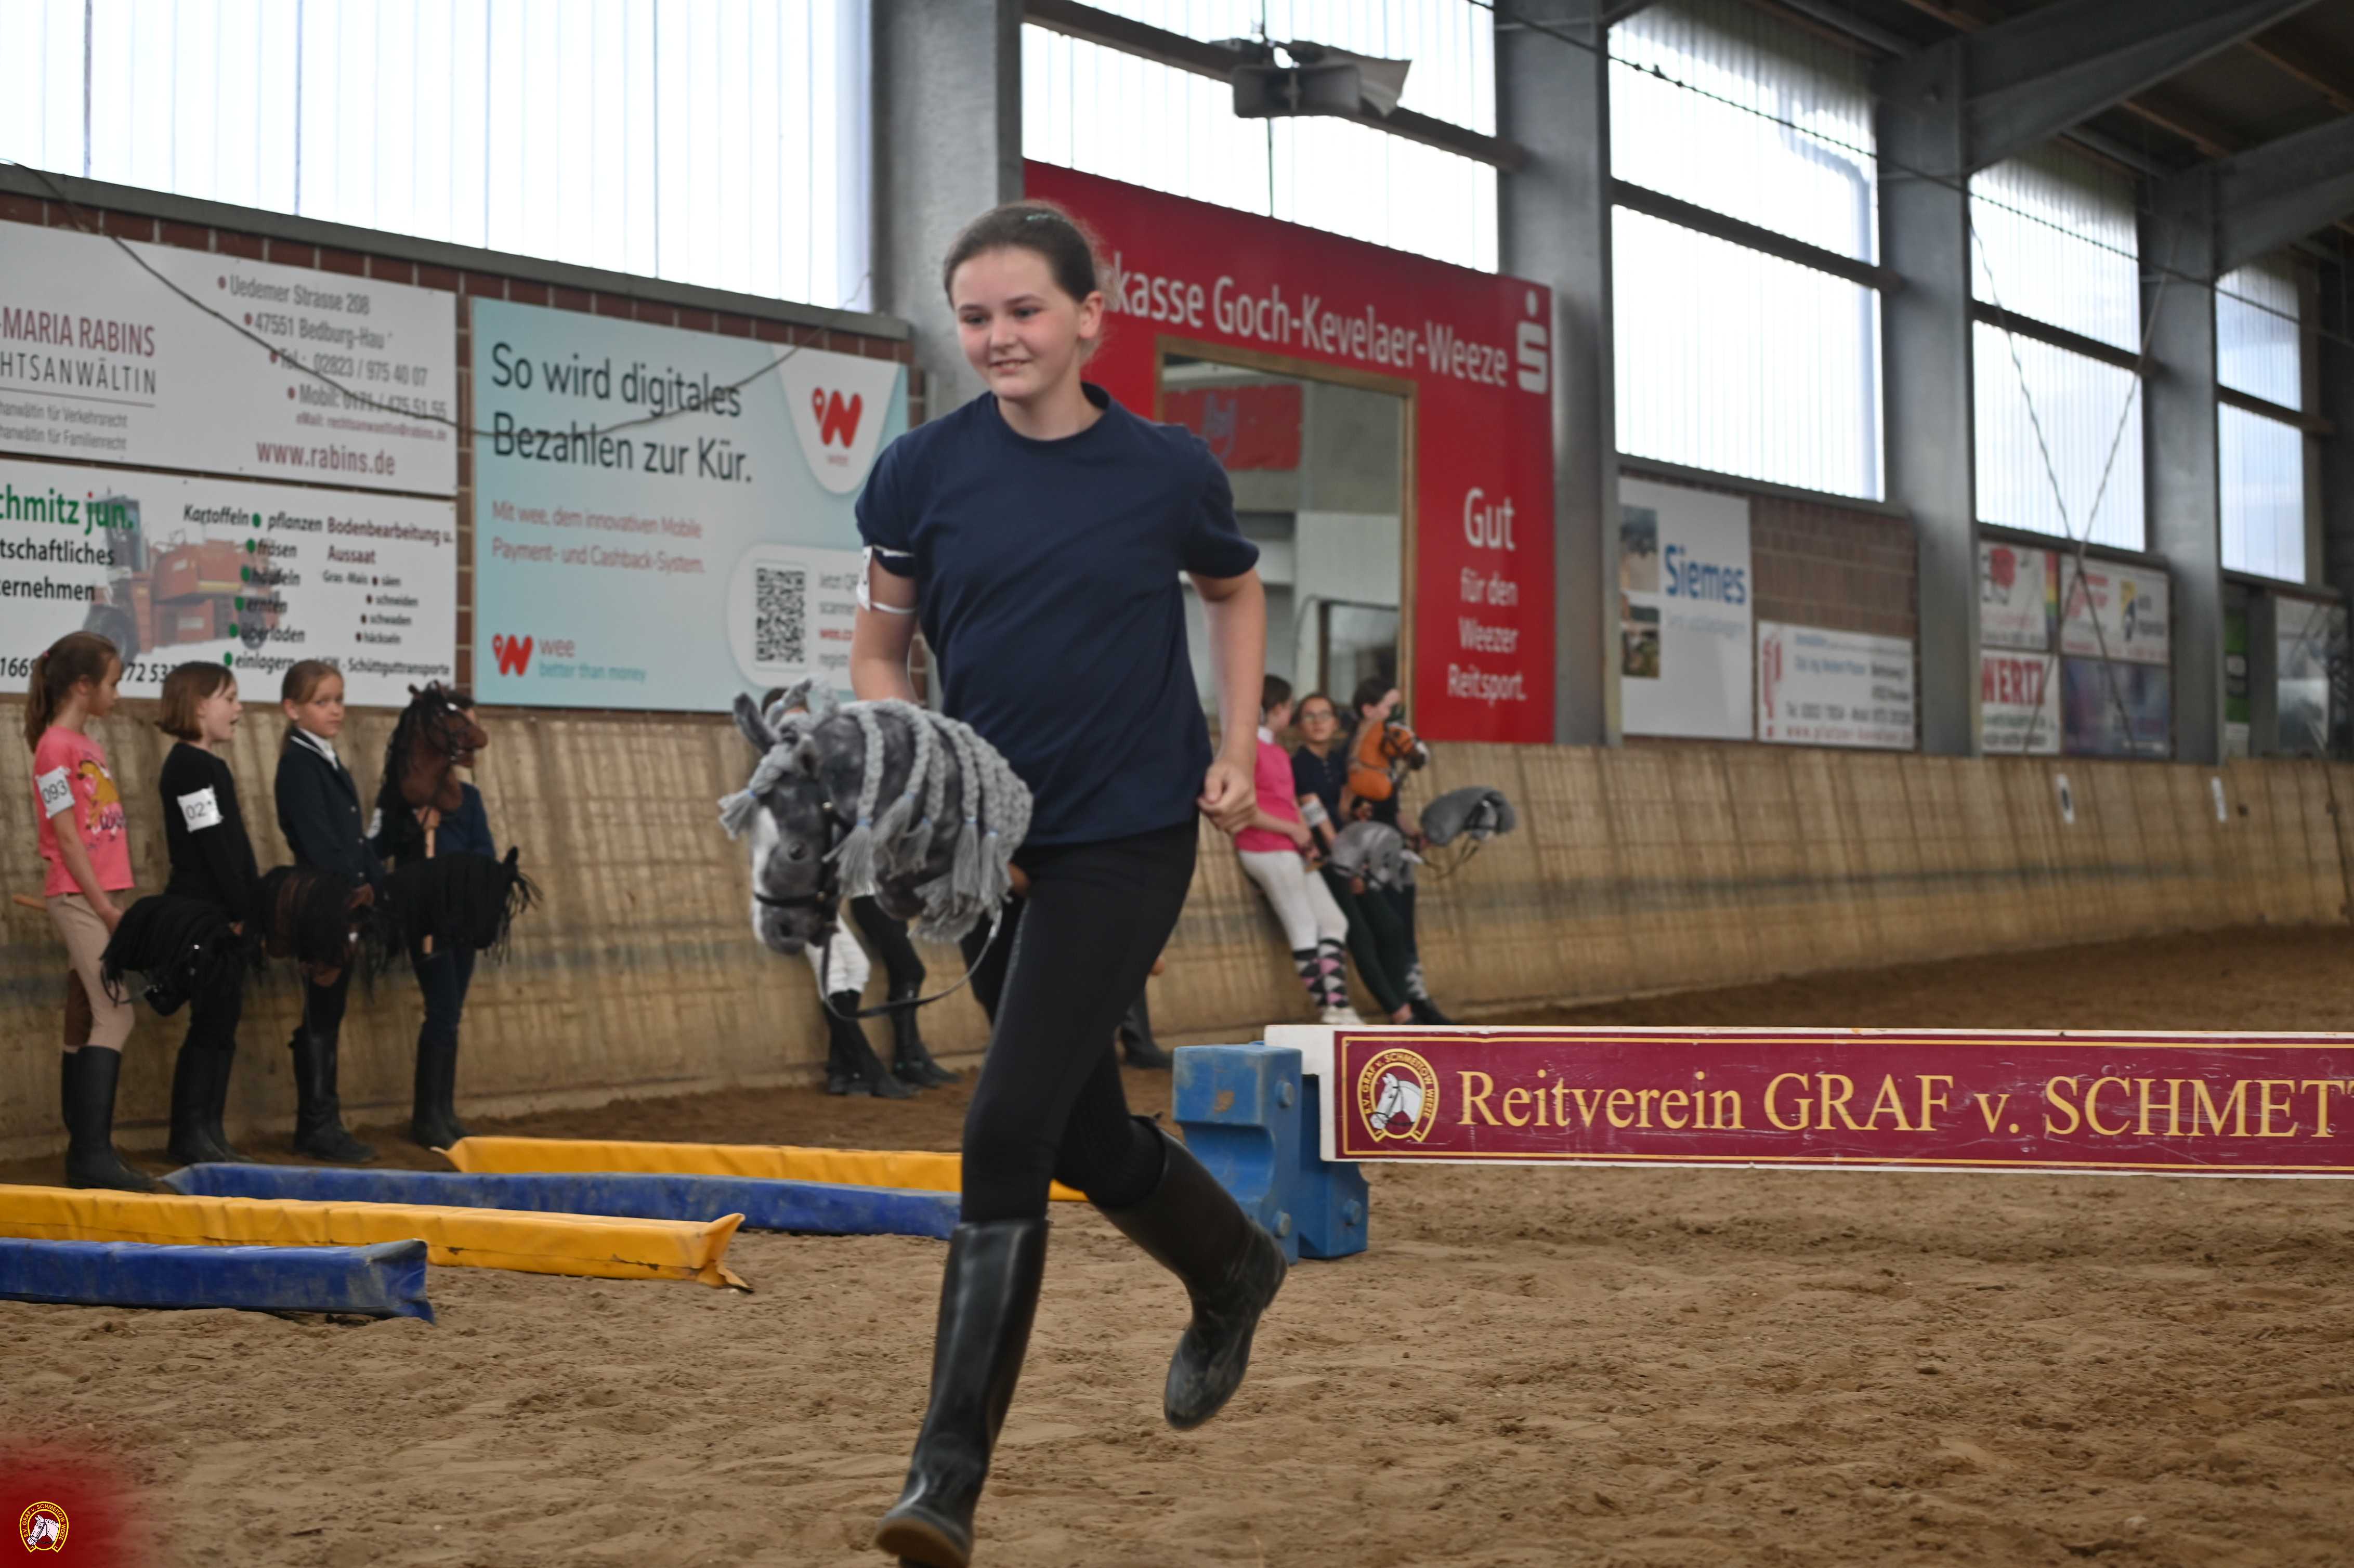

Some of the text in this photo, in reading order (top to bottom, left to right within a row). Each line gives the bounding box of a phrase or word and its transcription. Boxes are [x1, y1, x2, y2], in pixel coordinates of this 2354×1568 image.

[230, 275, 290, 303] Uedemer
[294, 285, 343, 311] Strasse
[0, 306, 155, 358] MARIA RABINS
[255, 312, 385, 350] 47551 Bedburg-Hau
[1213, 275, 1508, 388] Goch-Kevelaer-Weeze
[492, 342, 742, 417] So wird digitales
[256, 441, 395, 476] www.rabins.de
[493, 411, 752, 484] Bezahlen zur Kür.
[84, 491, 134, 536] jun.
[184, 503, 250, 526] Kartoffeln
[267, 510, 323, 532] pflanzen
[328, 516, 440, 547] Bodenbearbeitung
[492, 500, 515, 522] Mit
[553, 506, 582, 528] dem
[662, 515, 702, 539] Mobile
[1464, 487, 1516, 551] Gut
[0, 537, 115, 566] tschaftliches
[328, 544, 376, 565] Aussaat
[561, 545, 587, 566] und
[0, 576, 96, 602] ernehmen
[1487, 572, 1518, 607] den
[1665, 544, 1747, 605] Siemes
[540, 638, 575, 659] wee
[1459, 617, 1519, 655] Weezer
[1448, 662, 1527, 708] Reitsport.
[42, 780, 68, 804] 093
[1457, 1068, 1744, 1130] Reitverein
[1763, 1072, 1953, 1132] GRAF
[1974, 1093, 2019, 1134] v.
